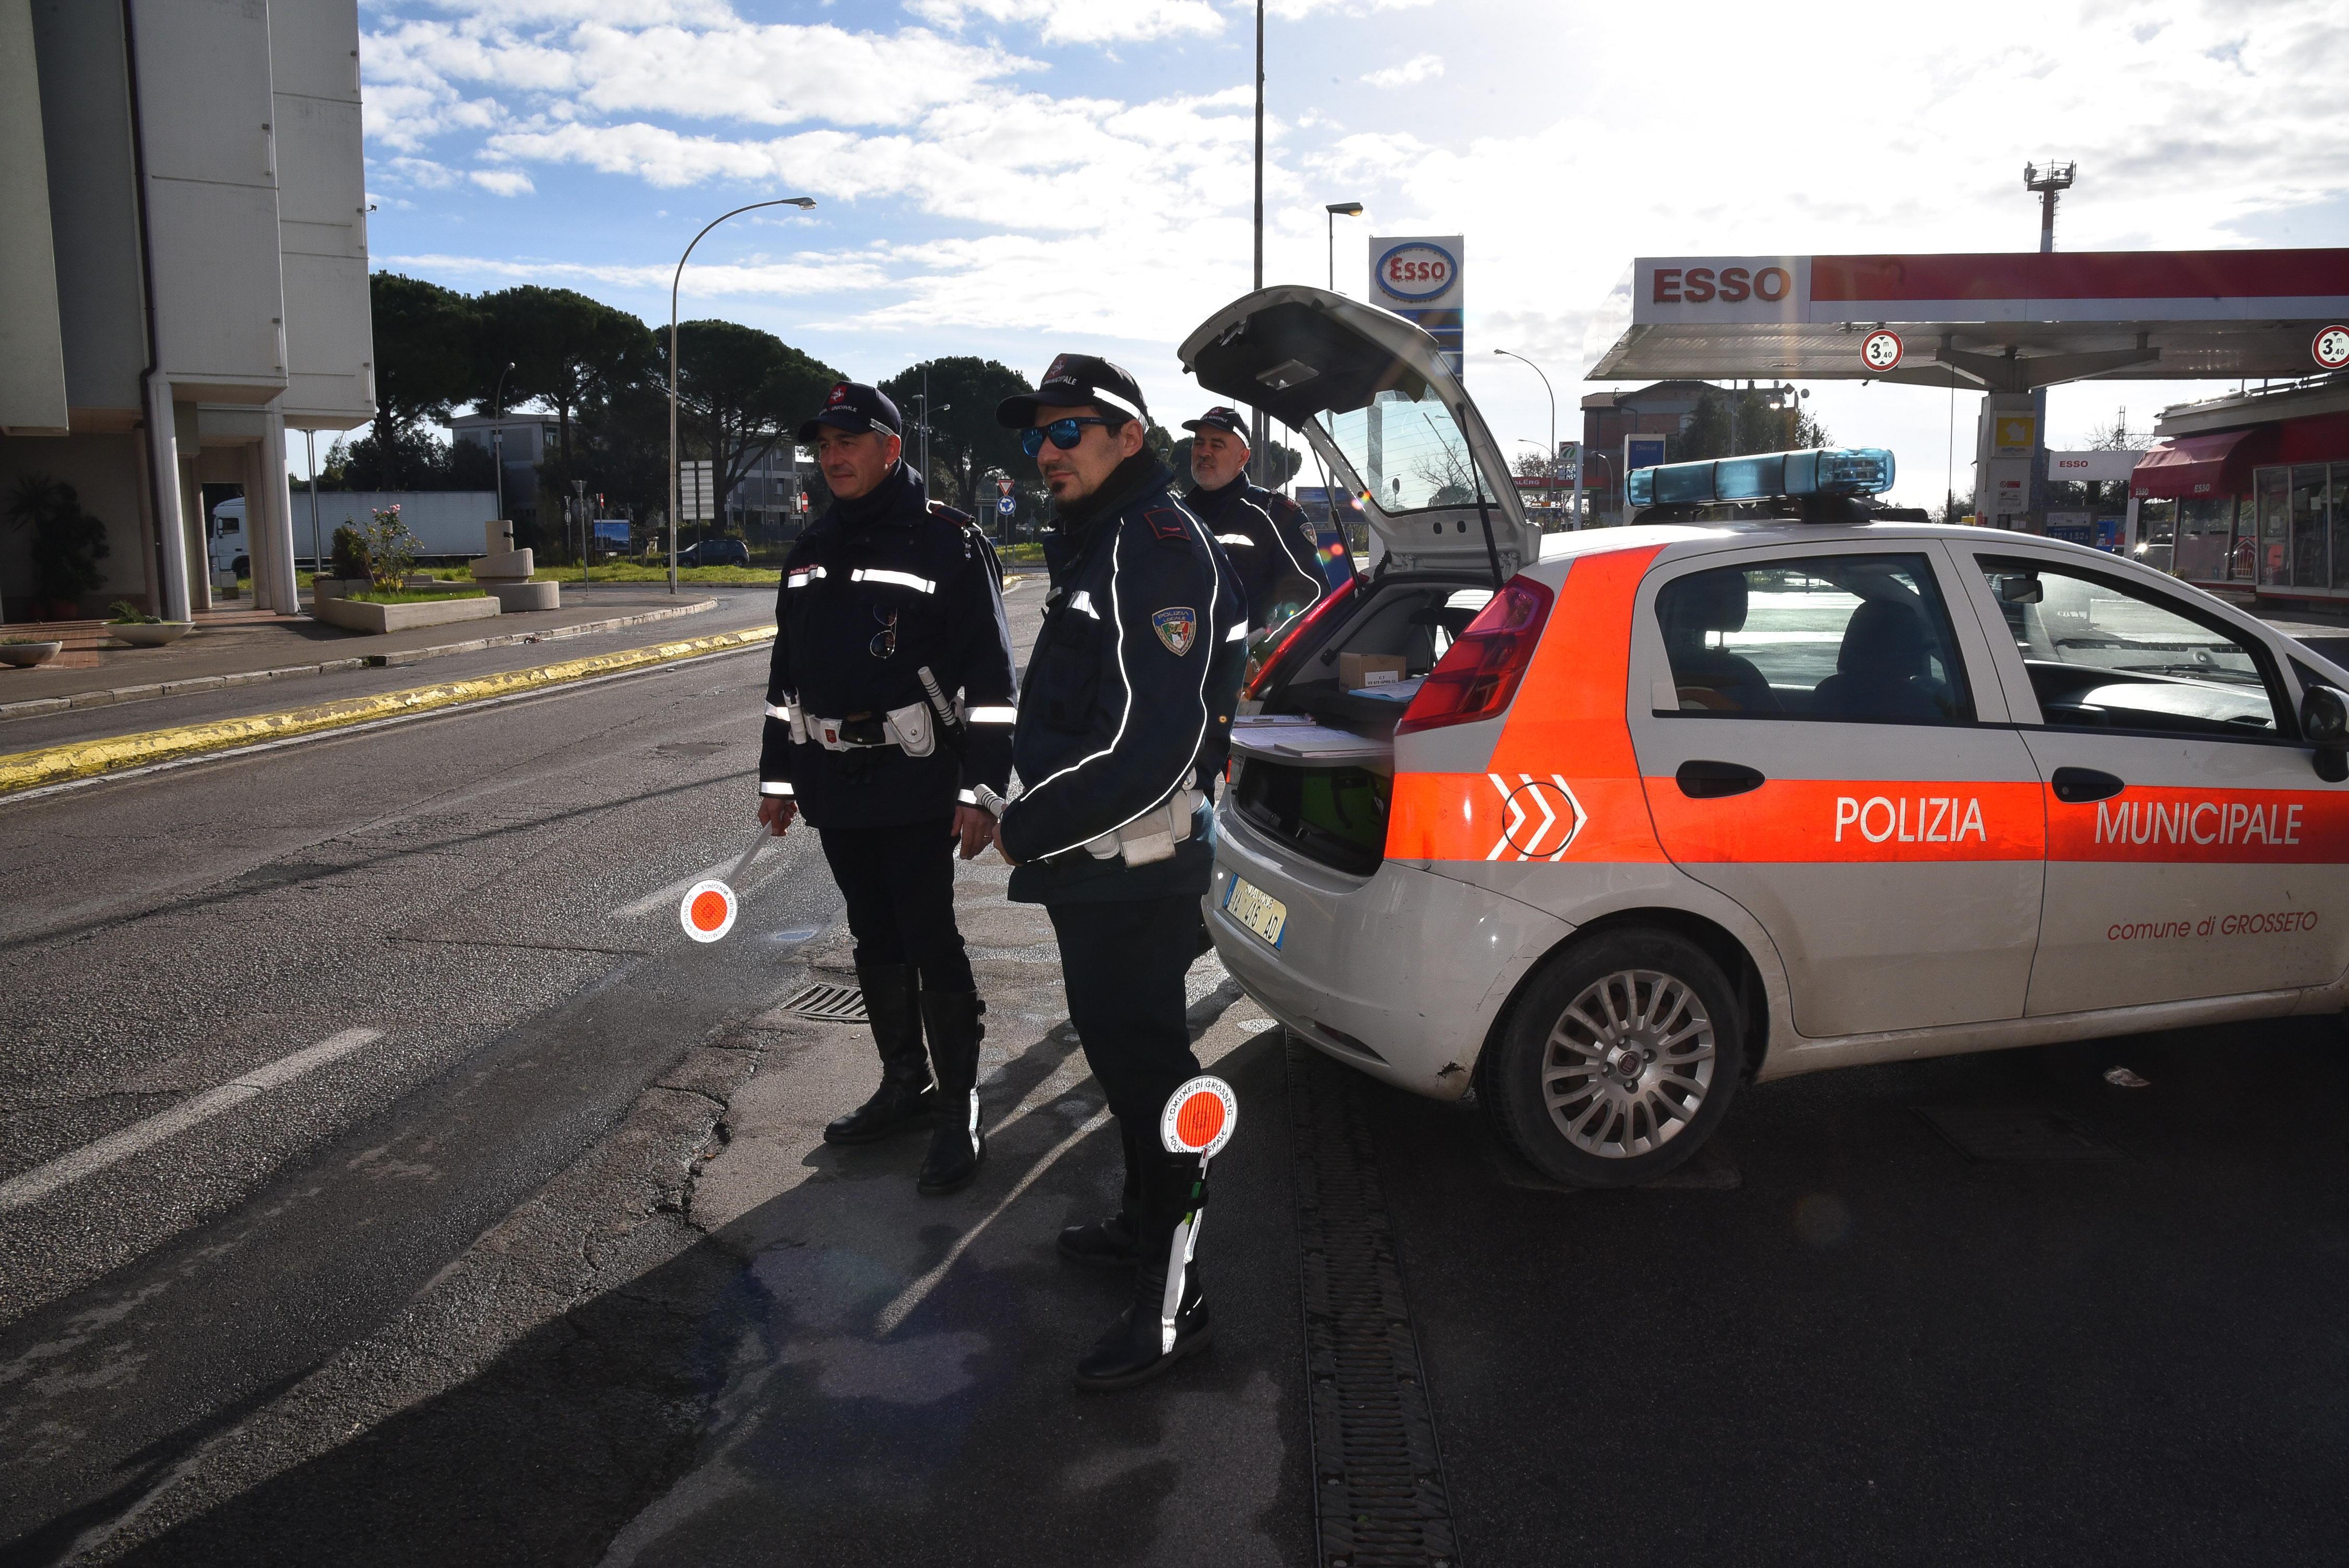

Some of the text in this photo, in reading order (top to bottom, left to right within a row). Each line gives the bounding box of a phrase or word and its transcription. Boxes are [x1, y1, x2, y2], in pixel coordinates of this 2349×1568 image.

[1653, 267, 1791, 302] ESSO
[2194, 483, 2210, 493] ESSO
[1158, 611, 1189, 620] POLIZIA
[1835, 797, 2304, 845] POLIZIA MUNICIPALE
[2107, 911, 2318, 940] comune di GROSSETO
[1168, 1081, 1233, 1121] COMUNE DI GROSSETO
[1169, 1135, 1187, 1153] POLIZI
